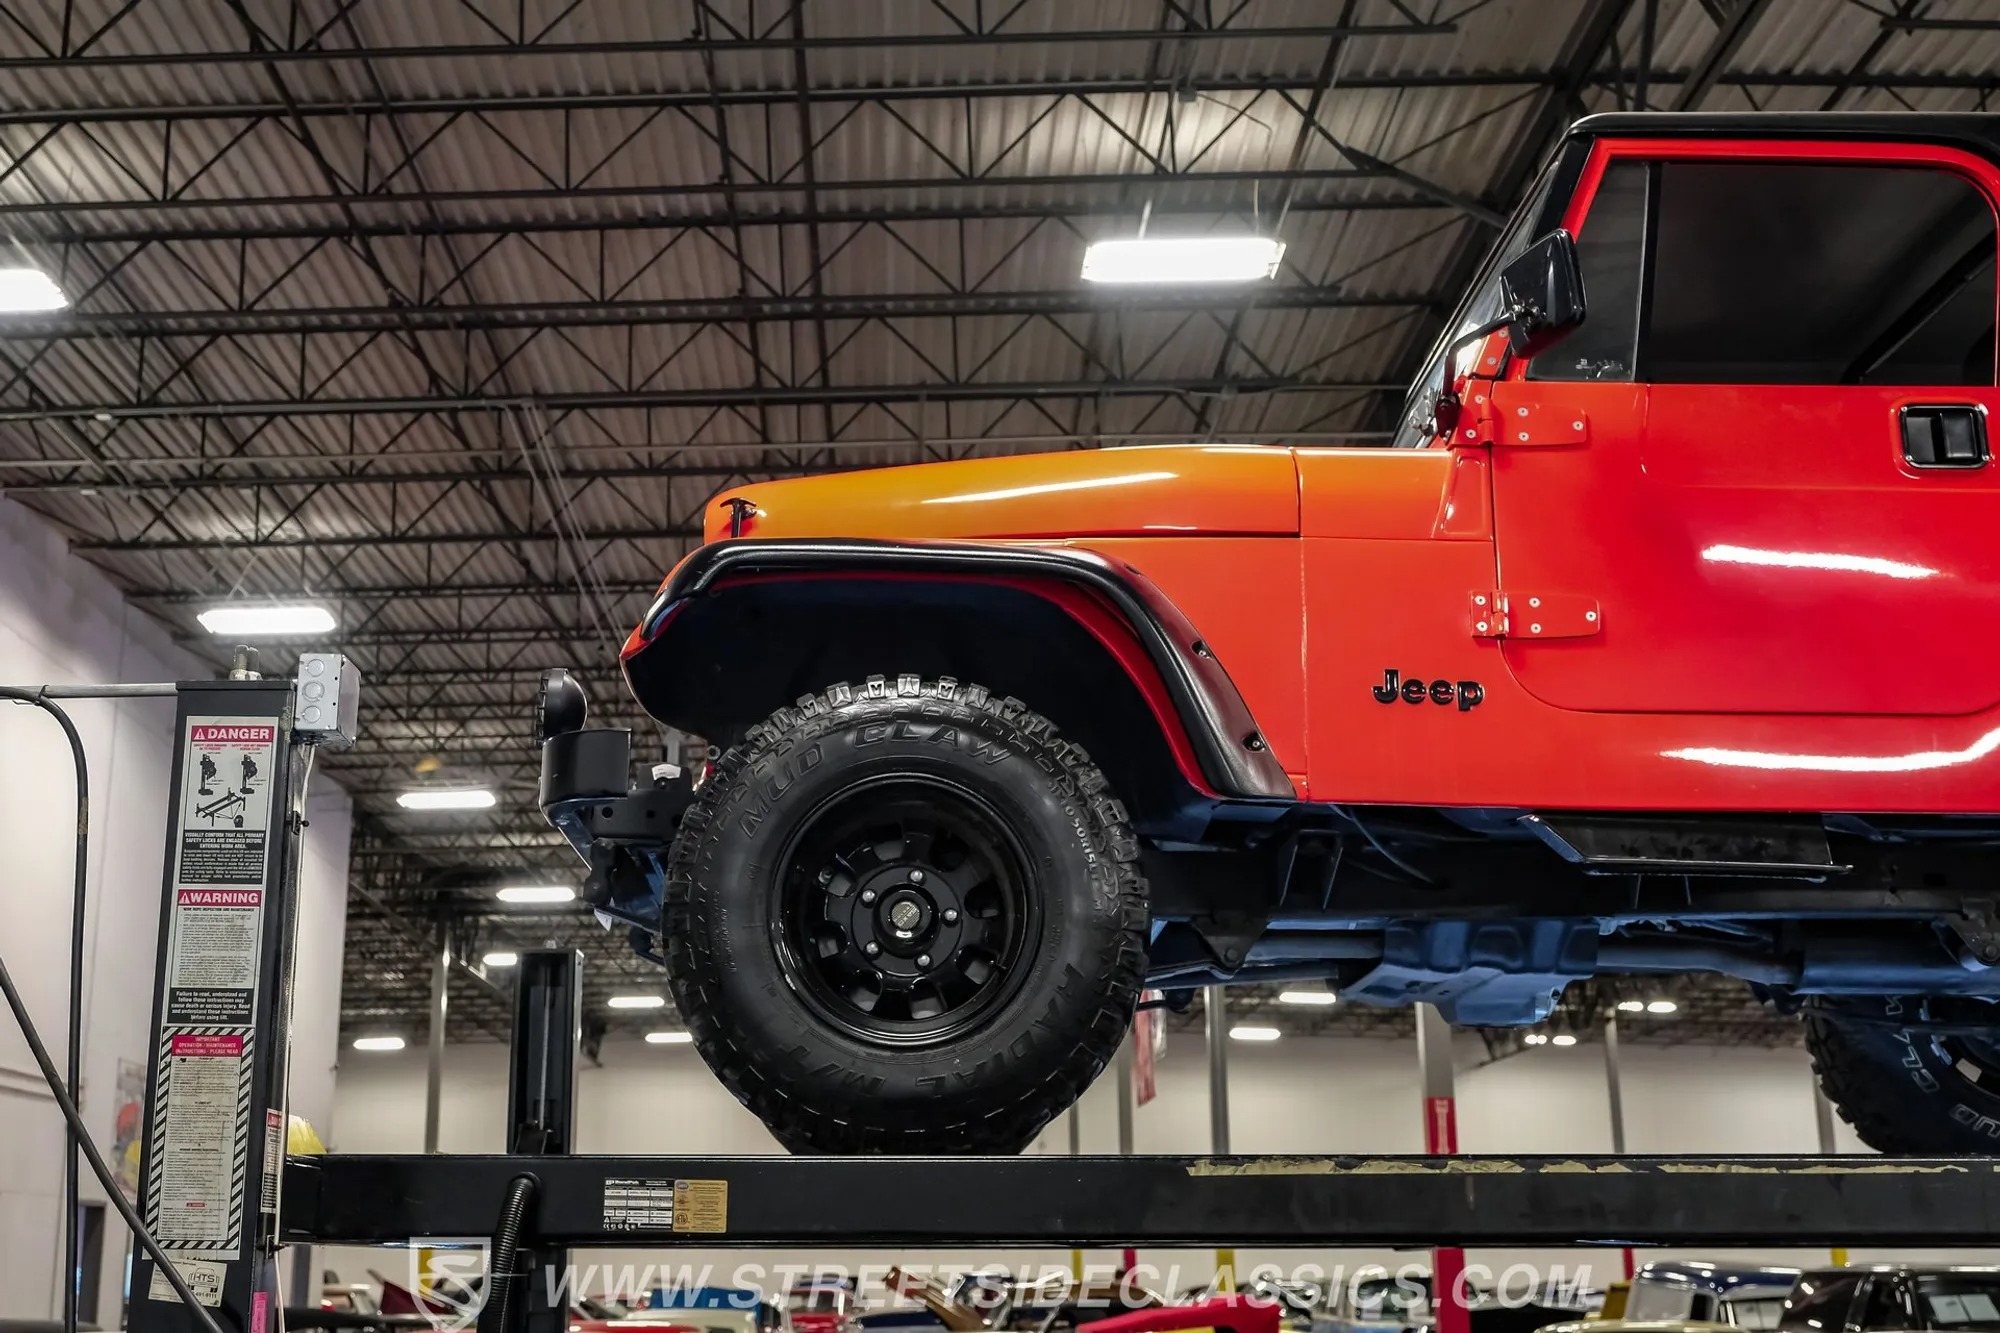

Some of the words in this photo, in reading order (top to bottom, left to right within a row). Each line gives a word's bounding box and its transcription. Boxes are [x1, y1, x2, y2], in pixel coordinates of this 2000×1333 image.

[1372, 669, 1485, 711] Jeep
[208, 728, 270, 740] DANGER
[738, 742, 823, 839] MUD
[853, 719, 1011, 765] CLAW
[190, 892, 258, 903] WARNING
[915, 963, 1086, 1097] RADIAL
[194, 1273, 214, 1283] HTS
